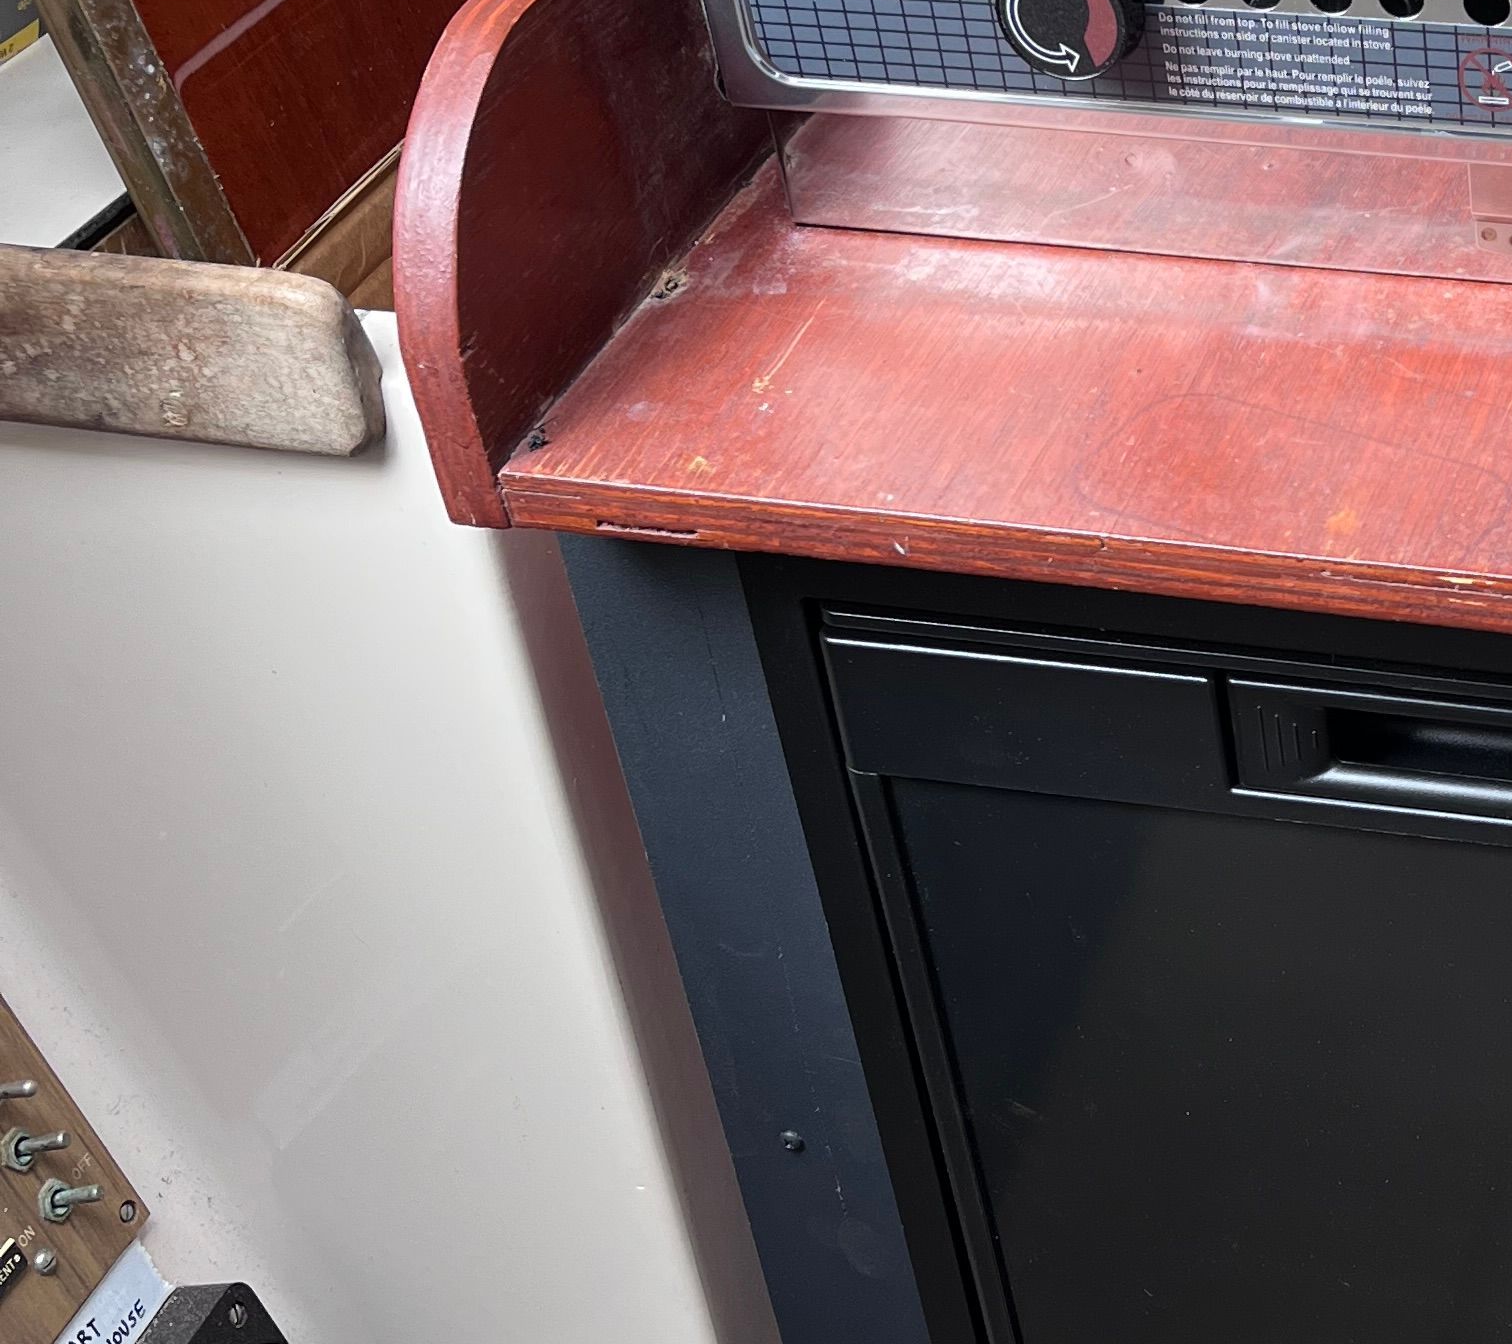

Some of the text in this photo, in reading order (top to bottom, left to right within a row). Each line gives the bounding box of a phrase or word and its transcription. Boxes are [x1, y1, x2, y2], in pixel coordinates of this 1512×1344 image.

[1158, 11, 1390, 39] Do not fill from top. To fill stove follow filling
[1160, 26, 1395, 51] instructions on side of canister located in stove.
[1162, 43, 1351, 66] Do not leave burning stove unattended
[1165, 60, 1179, 72] Ne
[1181, 63, 1199, 75] pas
[1200, 65, 1235, 78] remplir
[1236, 67, 1254, 80] par
[1254, 67, 1264, 77] le
[1291, 69, 1317, 81] Pour
[1317, 71, 1354, 86] remplir
[1354, 73, 1364, 85] le
[1397, 77, 1431, 89] suivez
[1167, 73, 1433, 101] les instructions pour le remplissage qui se trouvent sur
[1201, 88, 1215, 99] du
[1261, 91, 1273, 103] de
[1274, 93, 1334, 108] combustible
[1390, 101, 1404, 112] du
[71, 1152, 94, 1182] OFF
[17, 1225, 37, 1249] ON
